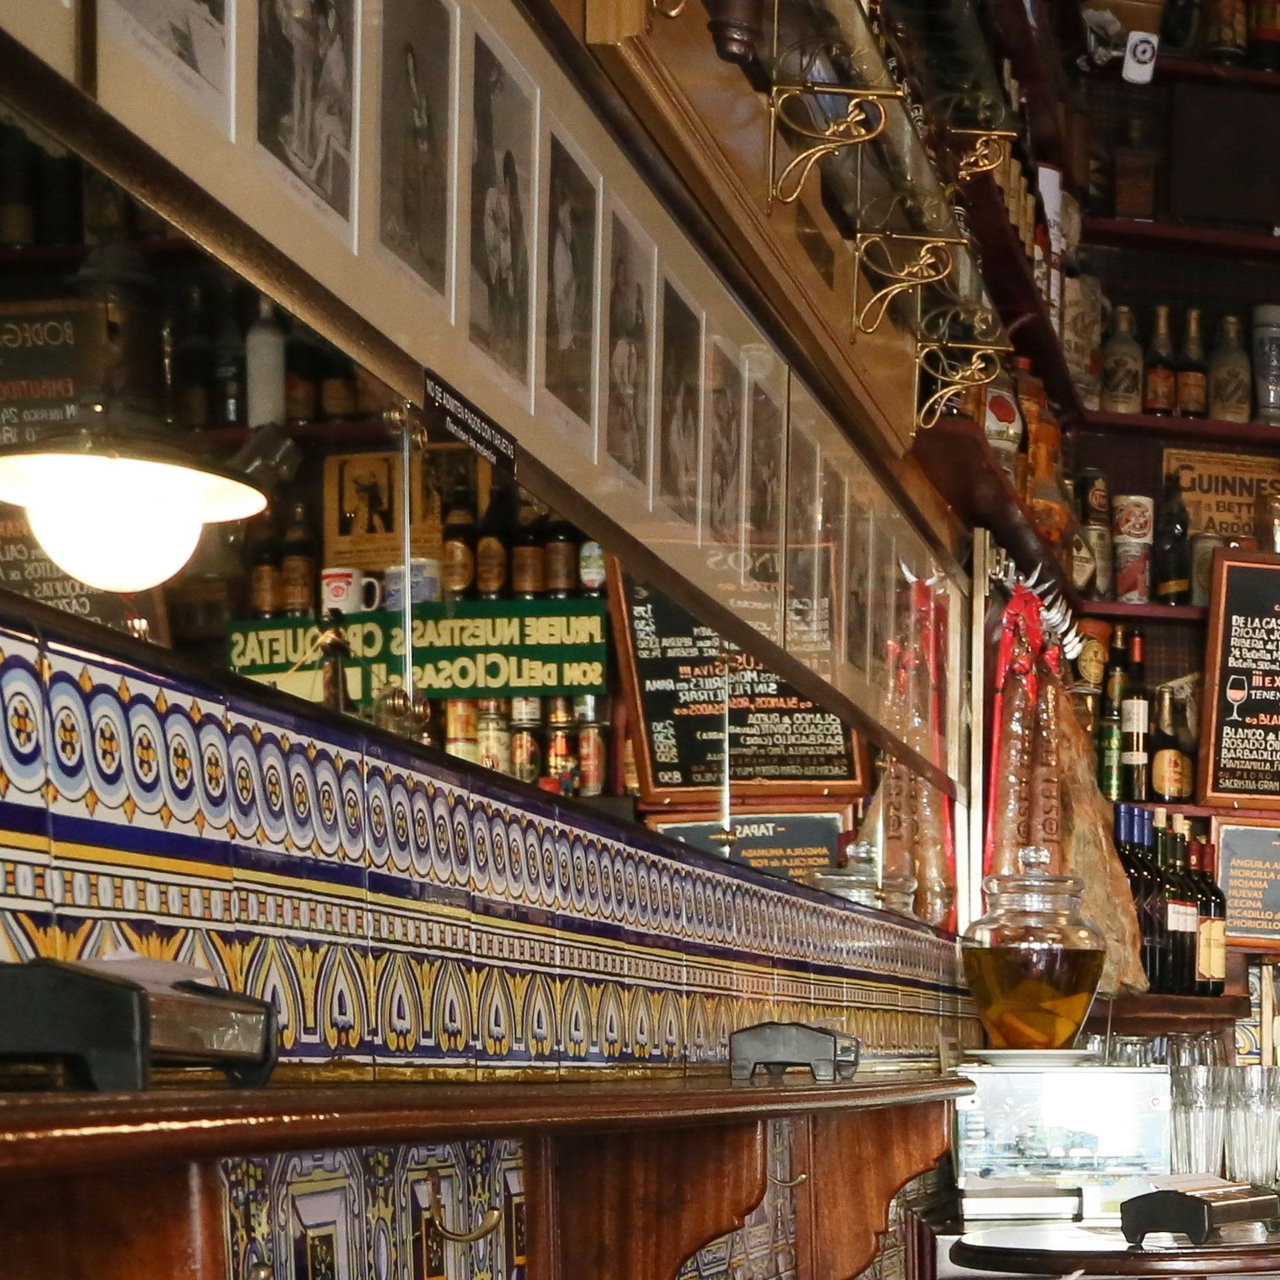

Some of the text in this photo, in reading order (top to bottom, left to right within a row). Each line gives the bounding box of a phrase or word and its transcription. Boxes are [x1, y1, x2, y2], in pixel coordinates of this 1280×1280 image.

[1231, 626, 1267, 640] RIOJA
[1230, 637, 1264, 649] RIBERA
[1222, 739, 1265, 751] ROSADO
[1230, 859, 1270, 869] ANGUILA
[1229, 869, 1275, 880] MORCILLA
[1229, 880, 1268, 889] MOJAMA
[1228, 889, 1263, 898] HUEVAS
[1227, 909, 1274, 920] PICADILLO
[1227, 919, 1280, 930] CHORICILLO
